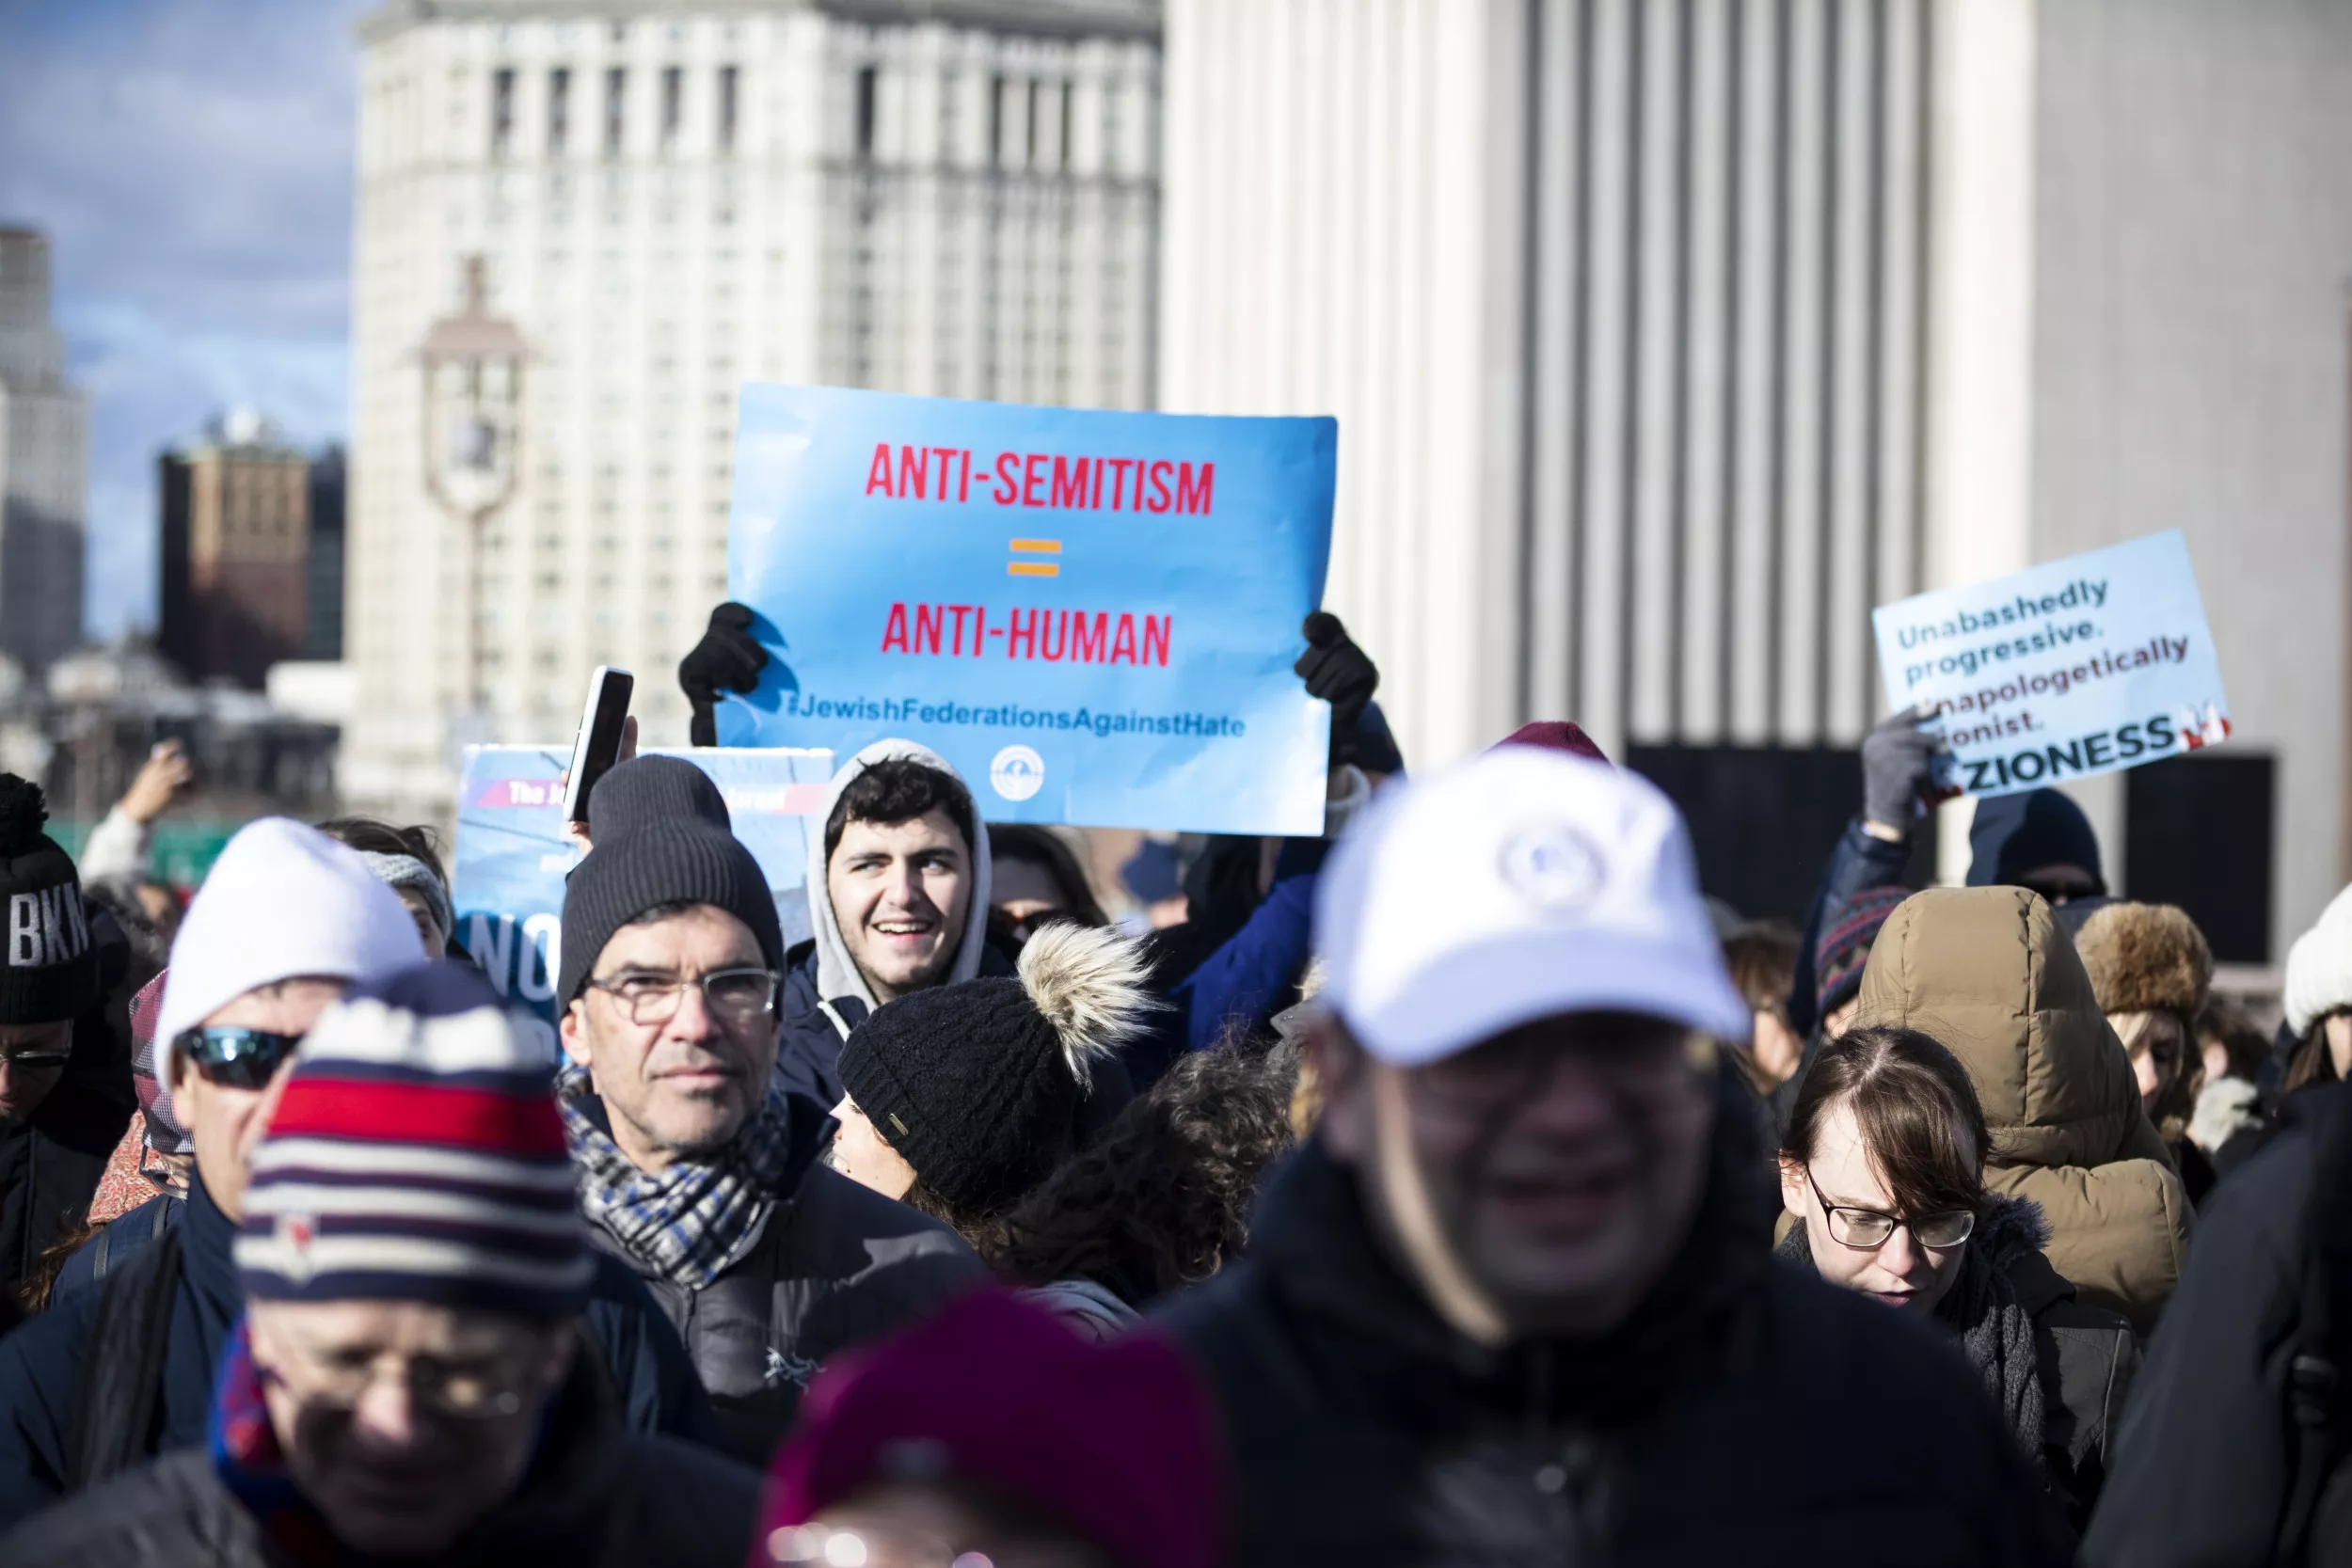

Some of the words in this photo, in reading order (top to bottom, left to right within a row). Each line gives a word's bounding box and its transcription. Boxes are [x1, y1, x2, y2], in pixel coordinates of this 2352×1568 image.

[865, 442, 1216, 516] ANTI-SEMITISM
[881, 602, 1172, 667] ANTI-HUMAN
[1898, 578, 2108, 649] Unabashedly
[1904, 618, 2104, 689] progressive.
[1934, 634, 2189, 716] napologetically
[1941, 708, 2044, 746] ionist.
[1963, 716, 2175, 792] ZIONESS
[8, 882, 89, 968] BKN
[469, 912, 562, 1003] NO
